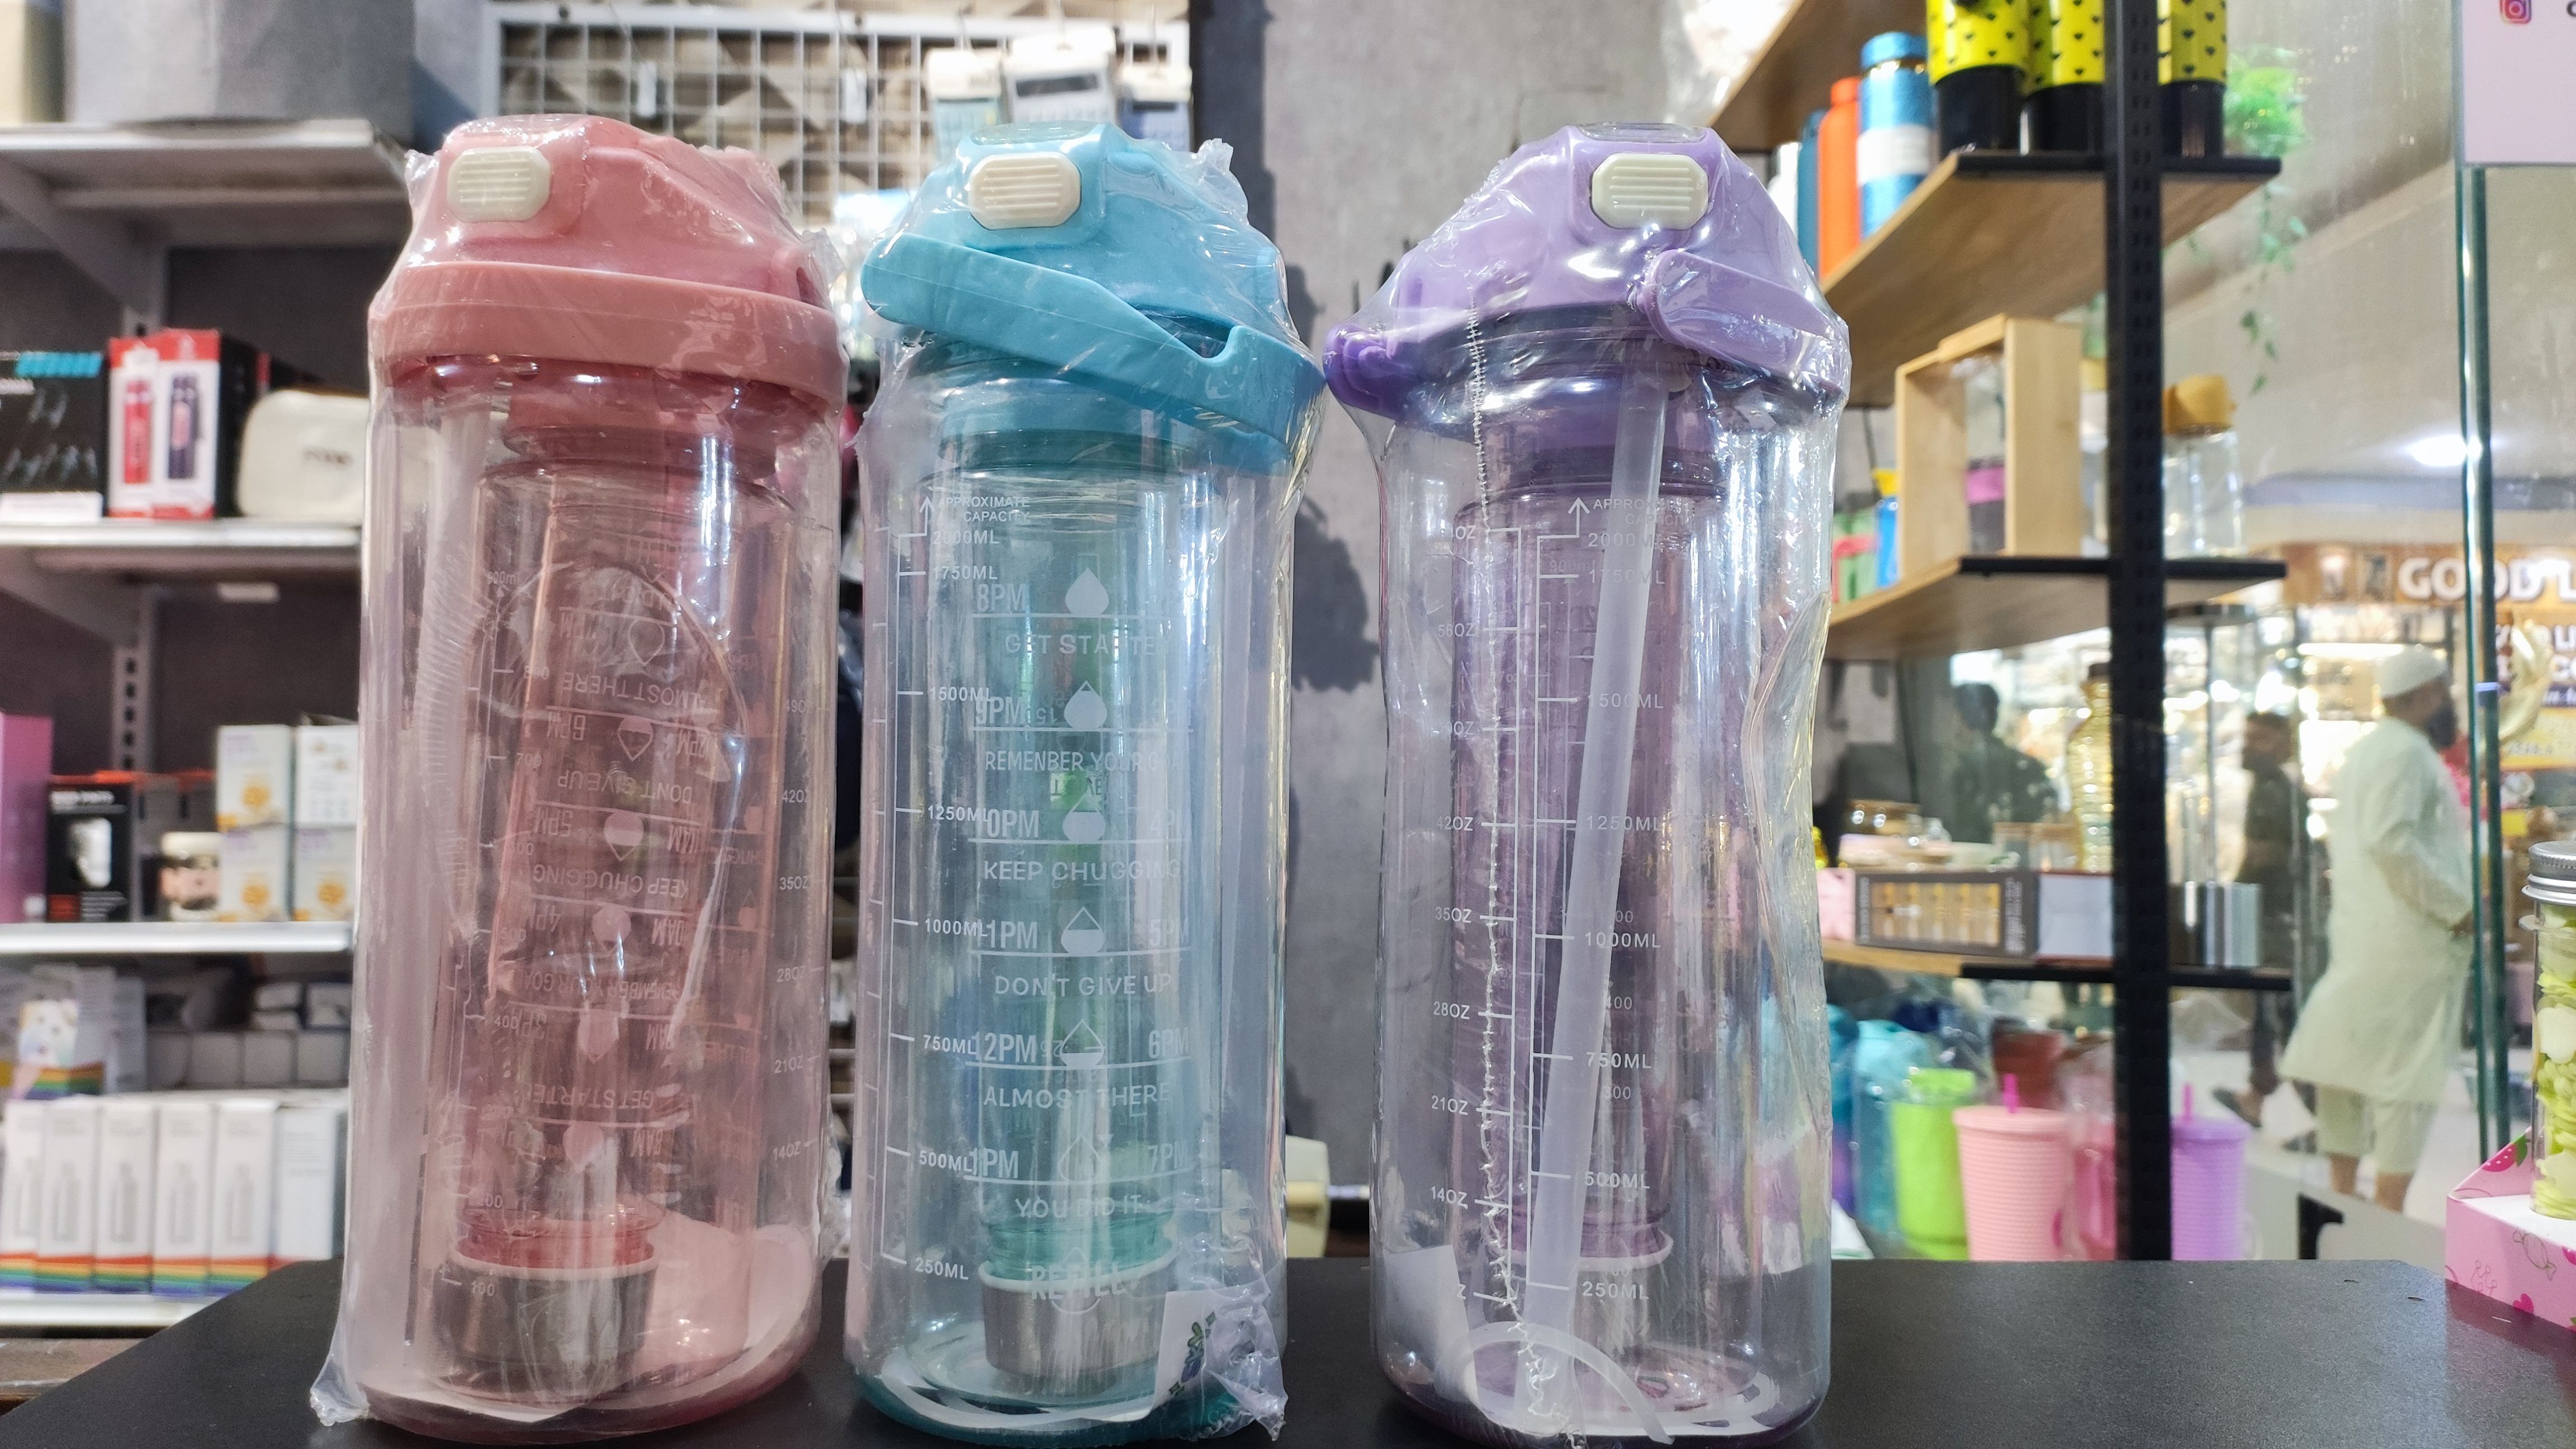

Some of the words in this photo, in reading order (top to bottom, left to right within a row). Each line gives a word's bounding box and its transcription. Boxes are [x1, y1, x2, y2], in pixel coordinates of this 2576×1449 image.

[938, 496, 1031, 508] APPROXIMATE
[963, 511, 1030, 522] CAPACITY
[933, 530, 1000, 544] 2000ML
[934, 565, 998, 580] 1750ML
[1589, 569, 1665, 585] 1750ML
[2398, 557, 2544, 600] GOD
[977, 583, 1027, 612] 8PM
[561, 671, 630, 698] THERE
[930, 686, 992, 703] 1500ML
[975, 696, 1027, 725] 9PM
[557, 769, 583, 788] UP
[927, 805, 989, 823] 1250ML
[1436, 816, 1474, 832] 42OZ
[1587, 815, 1663, 831] 1250ML
[533, 864, 644, 893] CHUGGING
[984, 860, 1043, 881] KEEP
[1051, 859, 1181, 881] CHUGGING
[1434, 906, 1472, 924] 35OZ
[924, 918, 988, 937] 1000ML
[1584, 931, 1662, 949] 1000ML
[995, 973, 1070, 997] DON'T
[1078, 976, 1137, 996] GIVE
[1143, 973, 1173, 993] UP
[1433, 1001, 1471, 1020] 28OZ
[922, 1034, 978, 1056] 750ML
[971, 1030, 1037, 1063] 12PM
[1148, 1026, 1189, 1059] 6PM
[774, 1055, 804, 1074] 21OZ
[1585, 1051, 1652, 1070] 750ML
[983, 1086, 1088, 1109] ALMOST
[1096, 1081, 1171, 1109] THERE
[1431, 1094, 1469, 1116] 21OZ
[771, 1140, 802, 1163] 14OZ
[918, 1149, 973, 1173] 500ML
[969, 1148, 1019, 1179] 1PM
[1584, 1171, 1651, 1190] 500ML
[1015, 1197, 1067, 1219] YOU
[1123, 1194, 1142, 1215] IT
[1431, 1185, 1469, 1210] 14OZ
[915, 1256, 969, 1281] 250ML
[1581, 1280, 1650, 1300] 250ML
